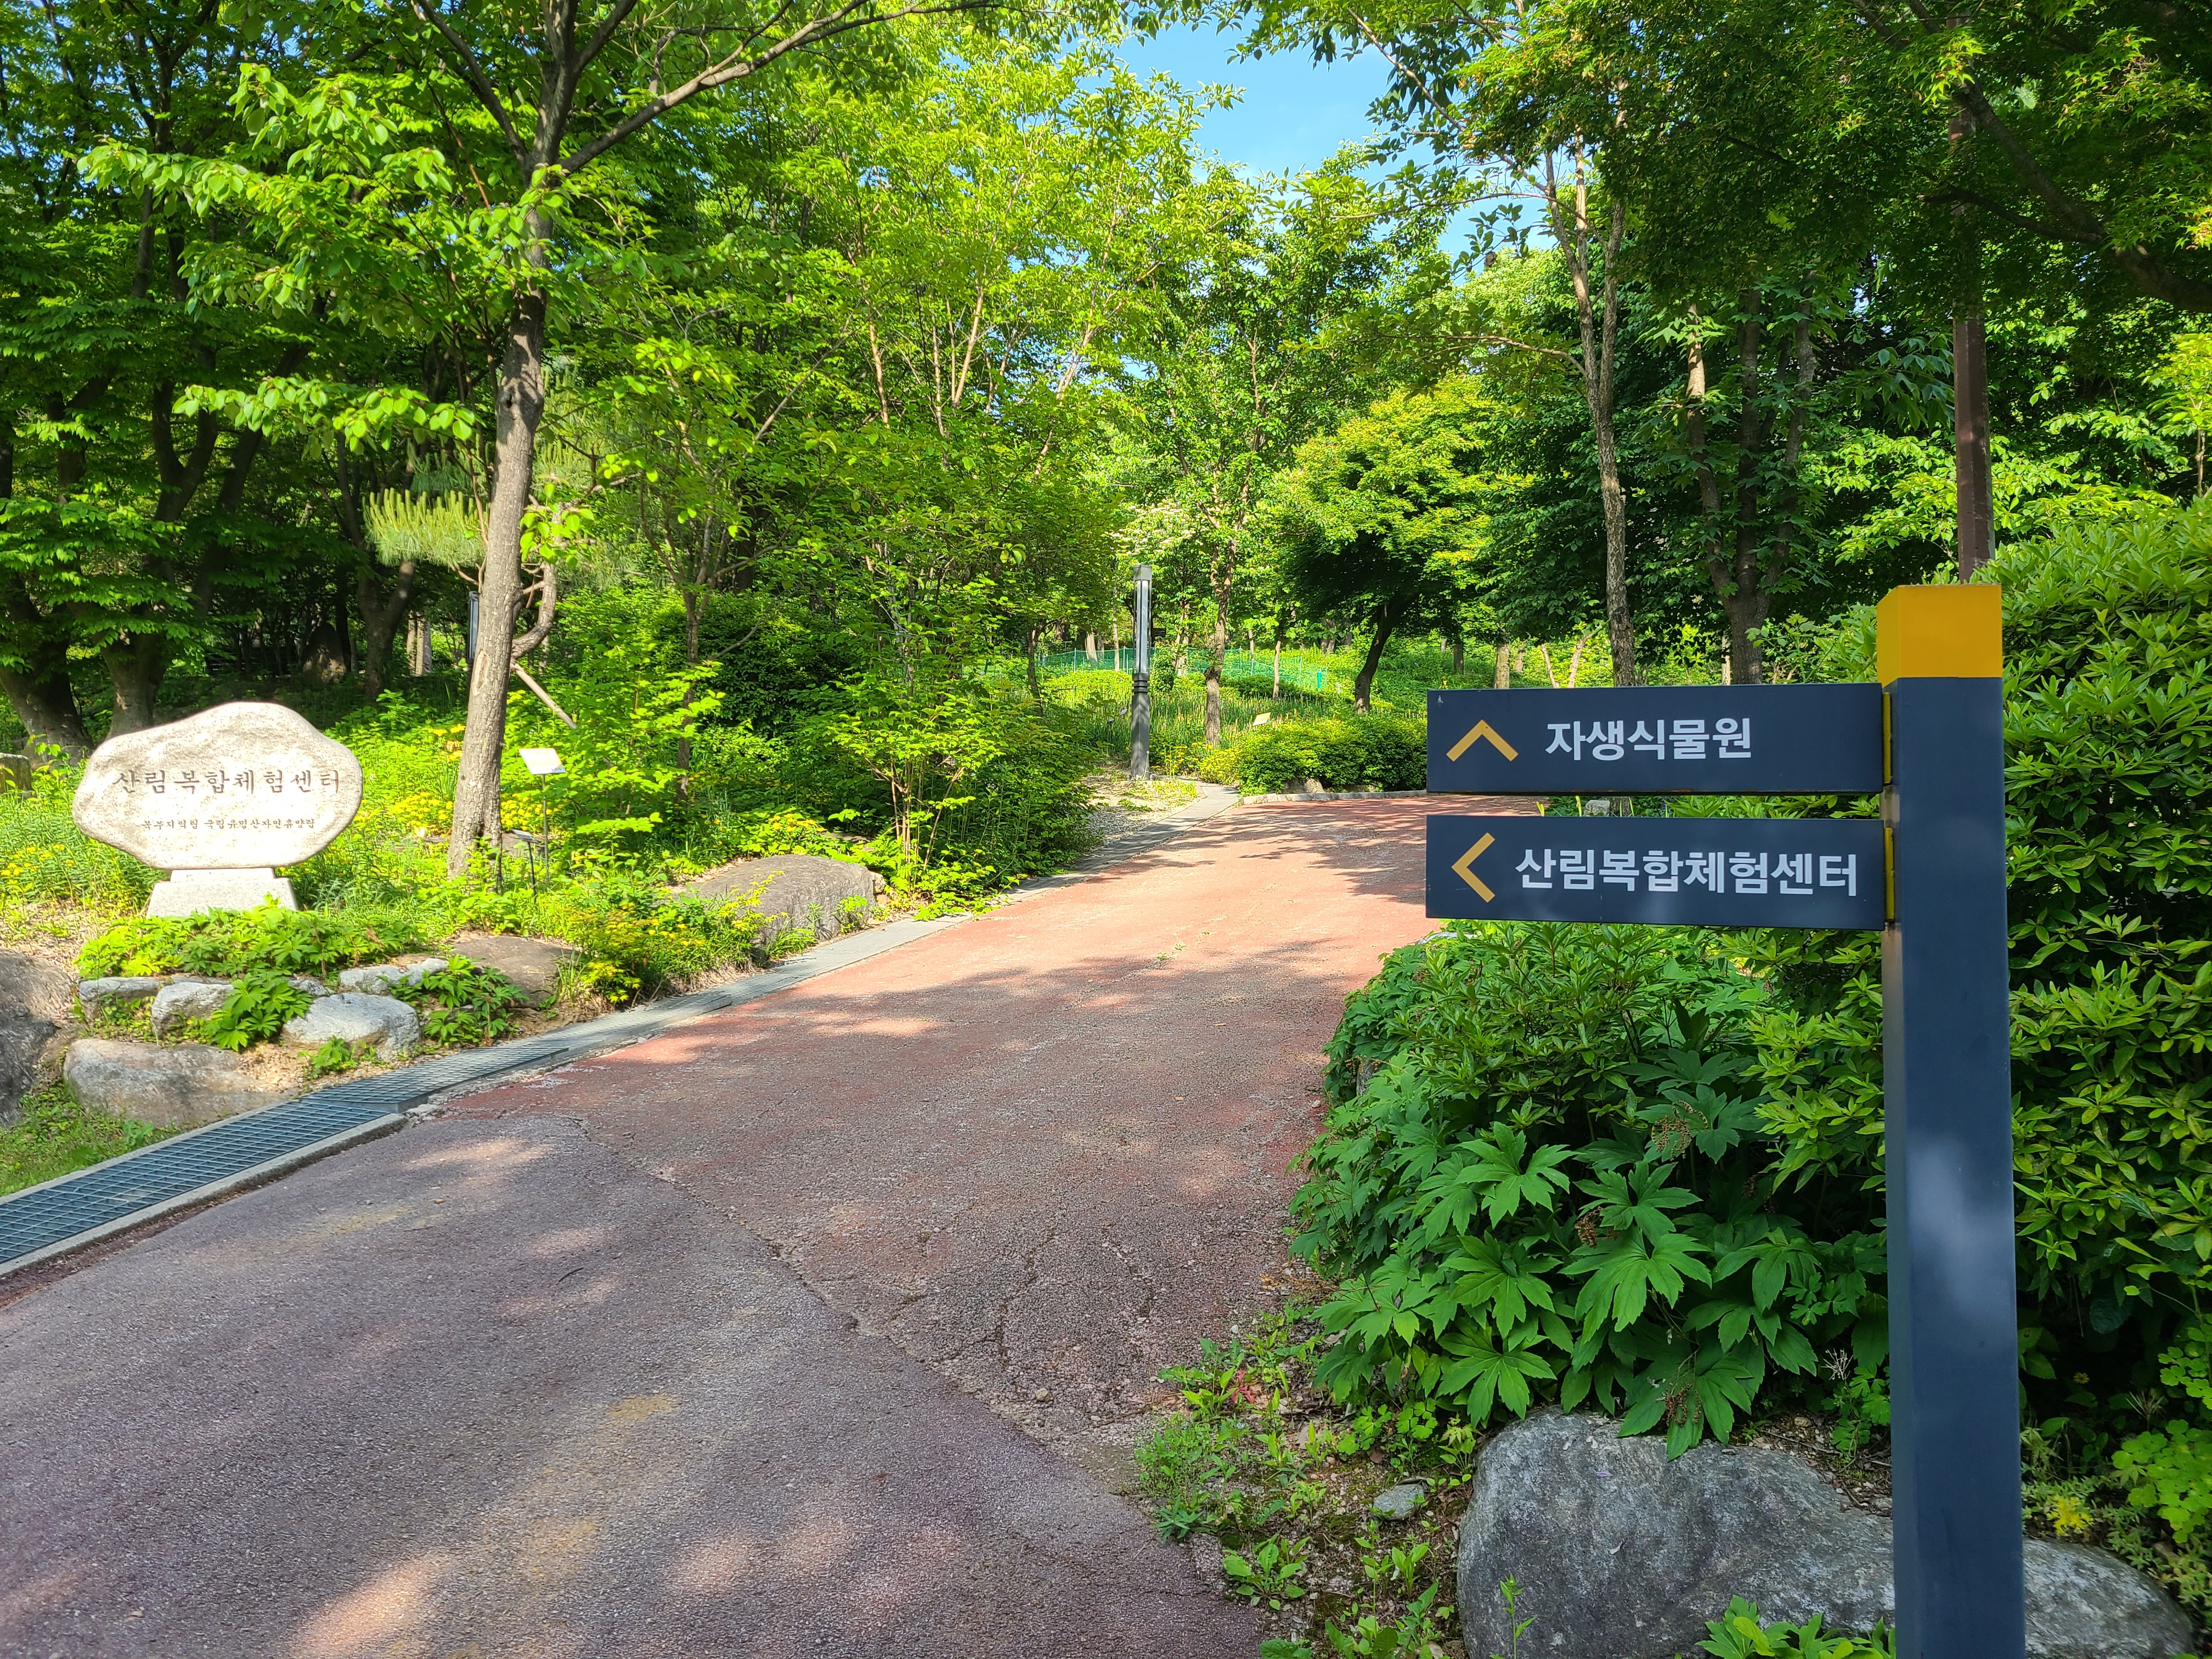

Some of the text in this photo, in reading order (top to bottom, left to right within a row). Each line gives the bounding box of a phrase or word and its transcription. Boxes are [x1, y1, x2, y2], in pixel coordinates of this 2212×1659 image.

[1545, 718, 1752, 761] 자생식물원
[112, 769, 340, 794] 산림복합체험센터
[1515, 848, 1857, 897] 산림복합체험센터
